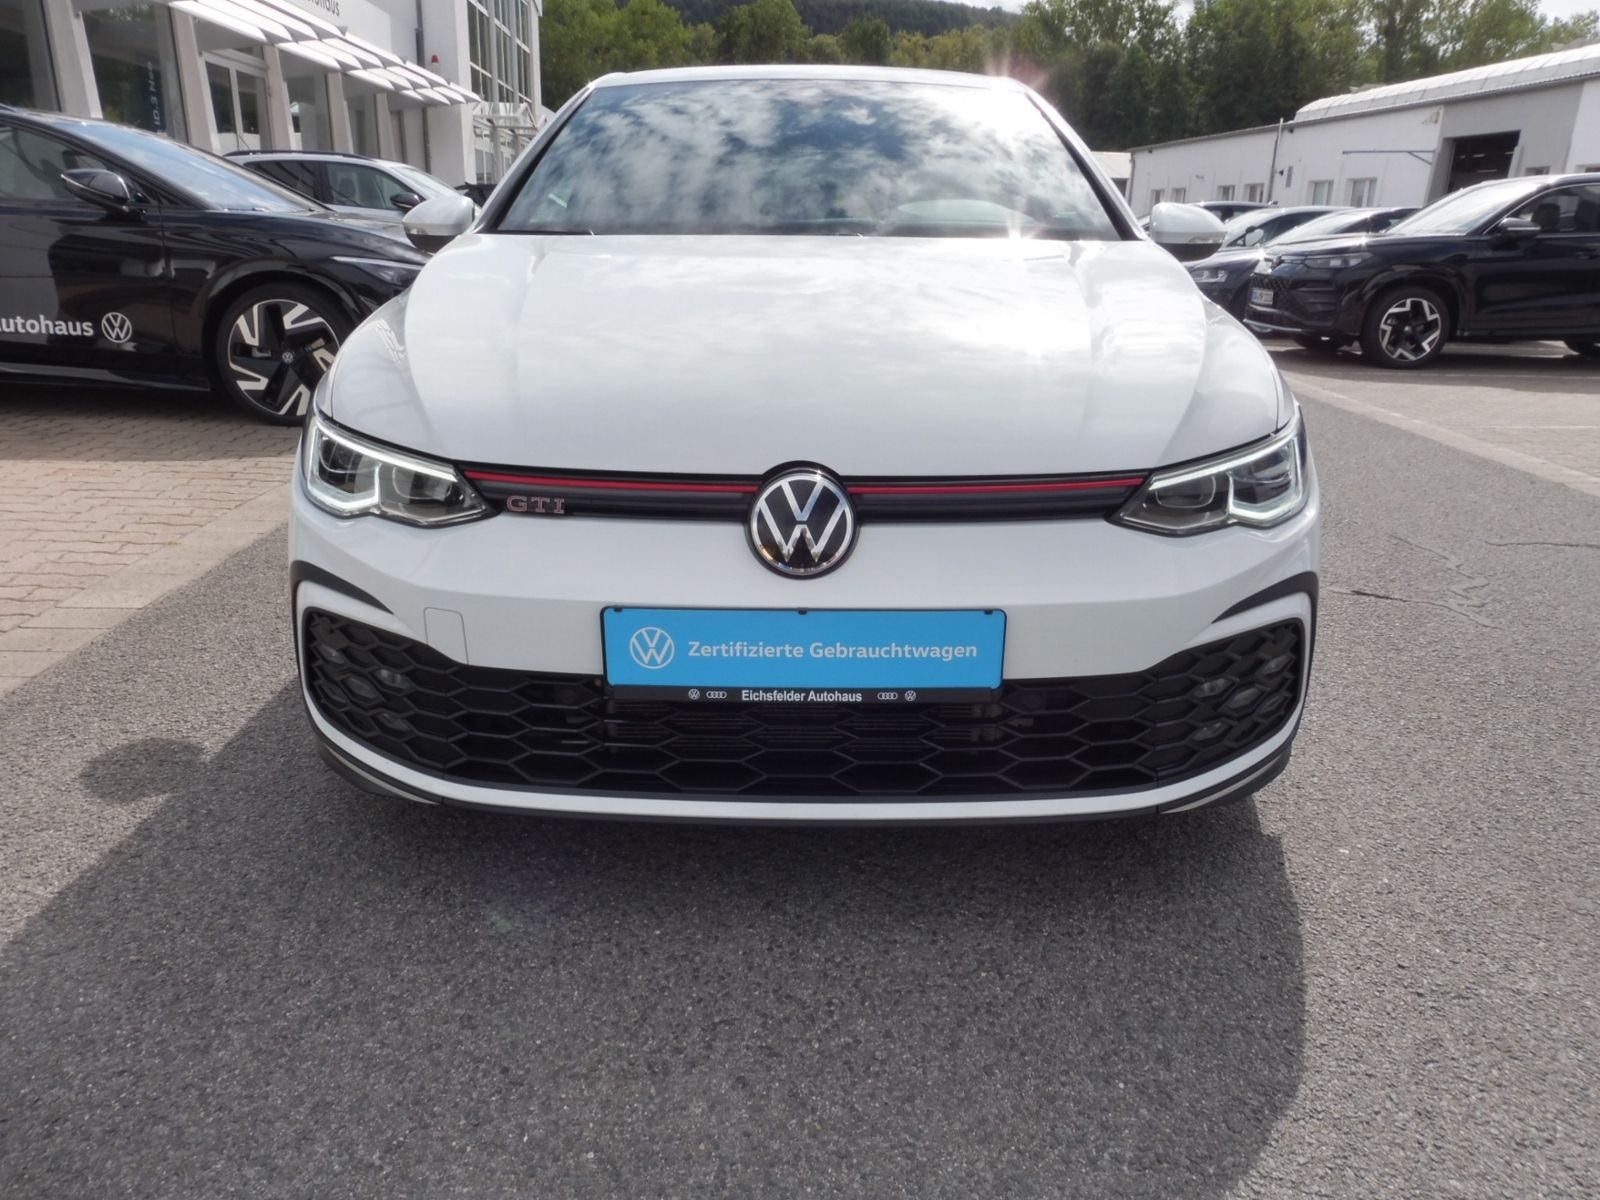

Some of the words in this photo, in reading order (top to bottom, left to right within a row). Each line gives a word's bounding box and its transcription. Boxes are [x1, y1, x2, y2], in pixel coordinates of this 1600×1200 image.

[0, 314, 94, 336] utohaus
[506, 495, 565, 515] GTI
[688, 641, 804, 659] Zertifizierte
[809, 642, 978, 661] Gebrauchtwagen
[741, 689, 806, 702] Eichsfelder
[808, 690, 863, 702] Autohaus
